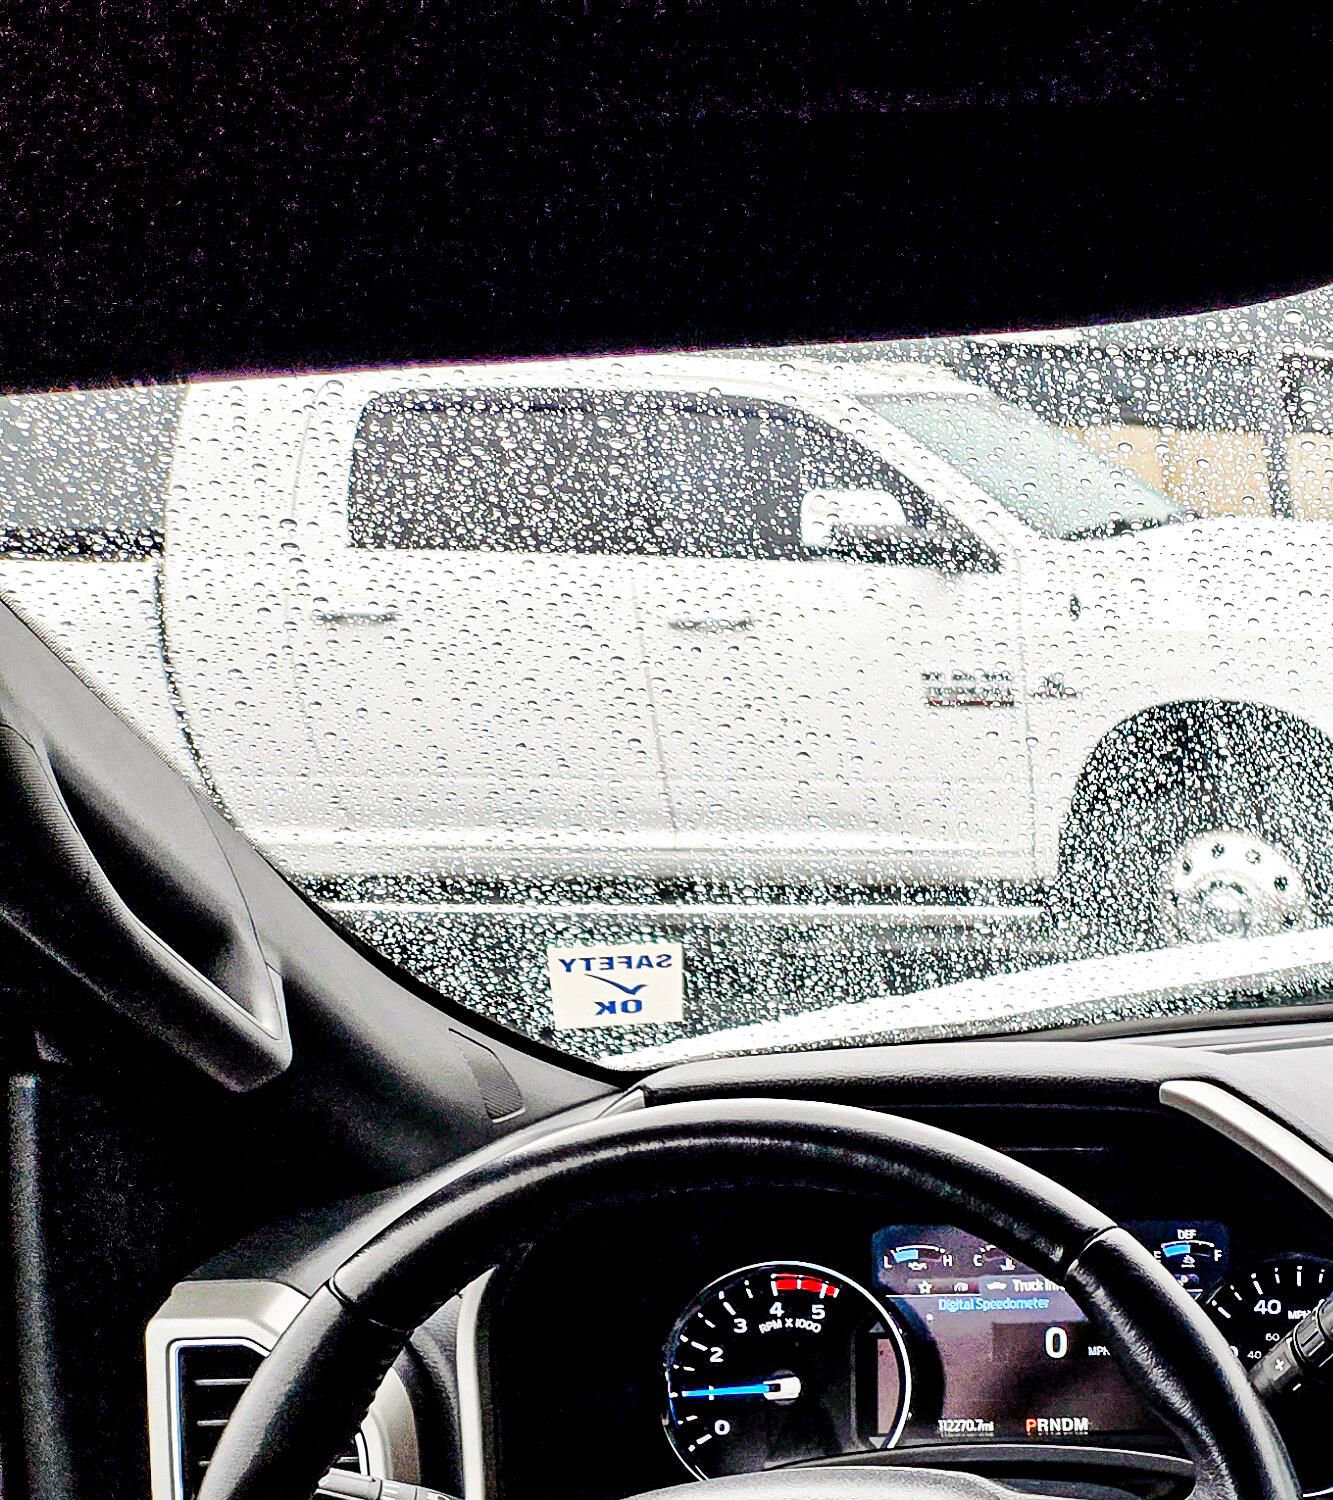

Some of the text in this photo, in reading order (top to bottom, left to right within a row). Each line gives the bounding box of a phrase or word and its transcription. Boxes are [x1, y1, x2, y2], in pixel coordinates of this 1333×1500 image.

[1177, 1229, 1197, 1240] DEF
[943, 1255, 953, 1267] H
[973, 1255, 983, 1266] C
[1214, 1250, 1223, 1261] F
[769, 1301, 785, 1317] 4
[811, 1304, 826, 1320] 5
[938, 1298, 1050, 1312] Digital Speedometer
[1253, 1300, 1282, 1315] 40
[733, 1318, 748, 1334] 3
[758, 1319, 783, 1334] RPM
[795, 1318, 822, 1334] 1000
[1045, 1326, 1068, 1359] 0
[1265, 1332, 1280, 1342] 60
[709, 1346, 724, 1363] 2
[1247, 1350, 1262, 1360] 40
[714, 1419, 731, 1435] 0
